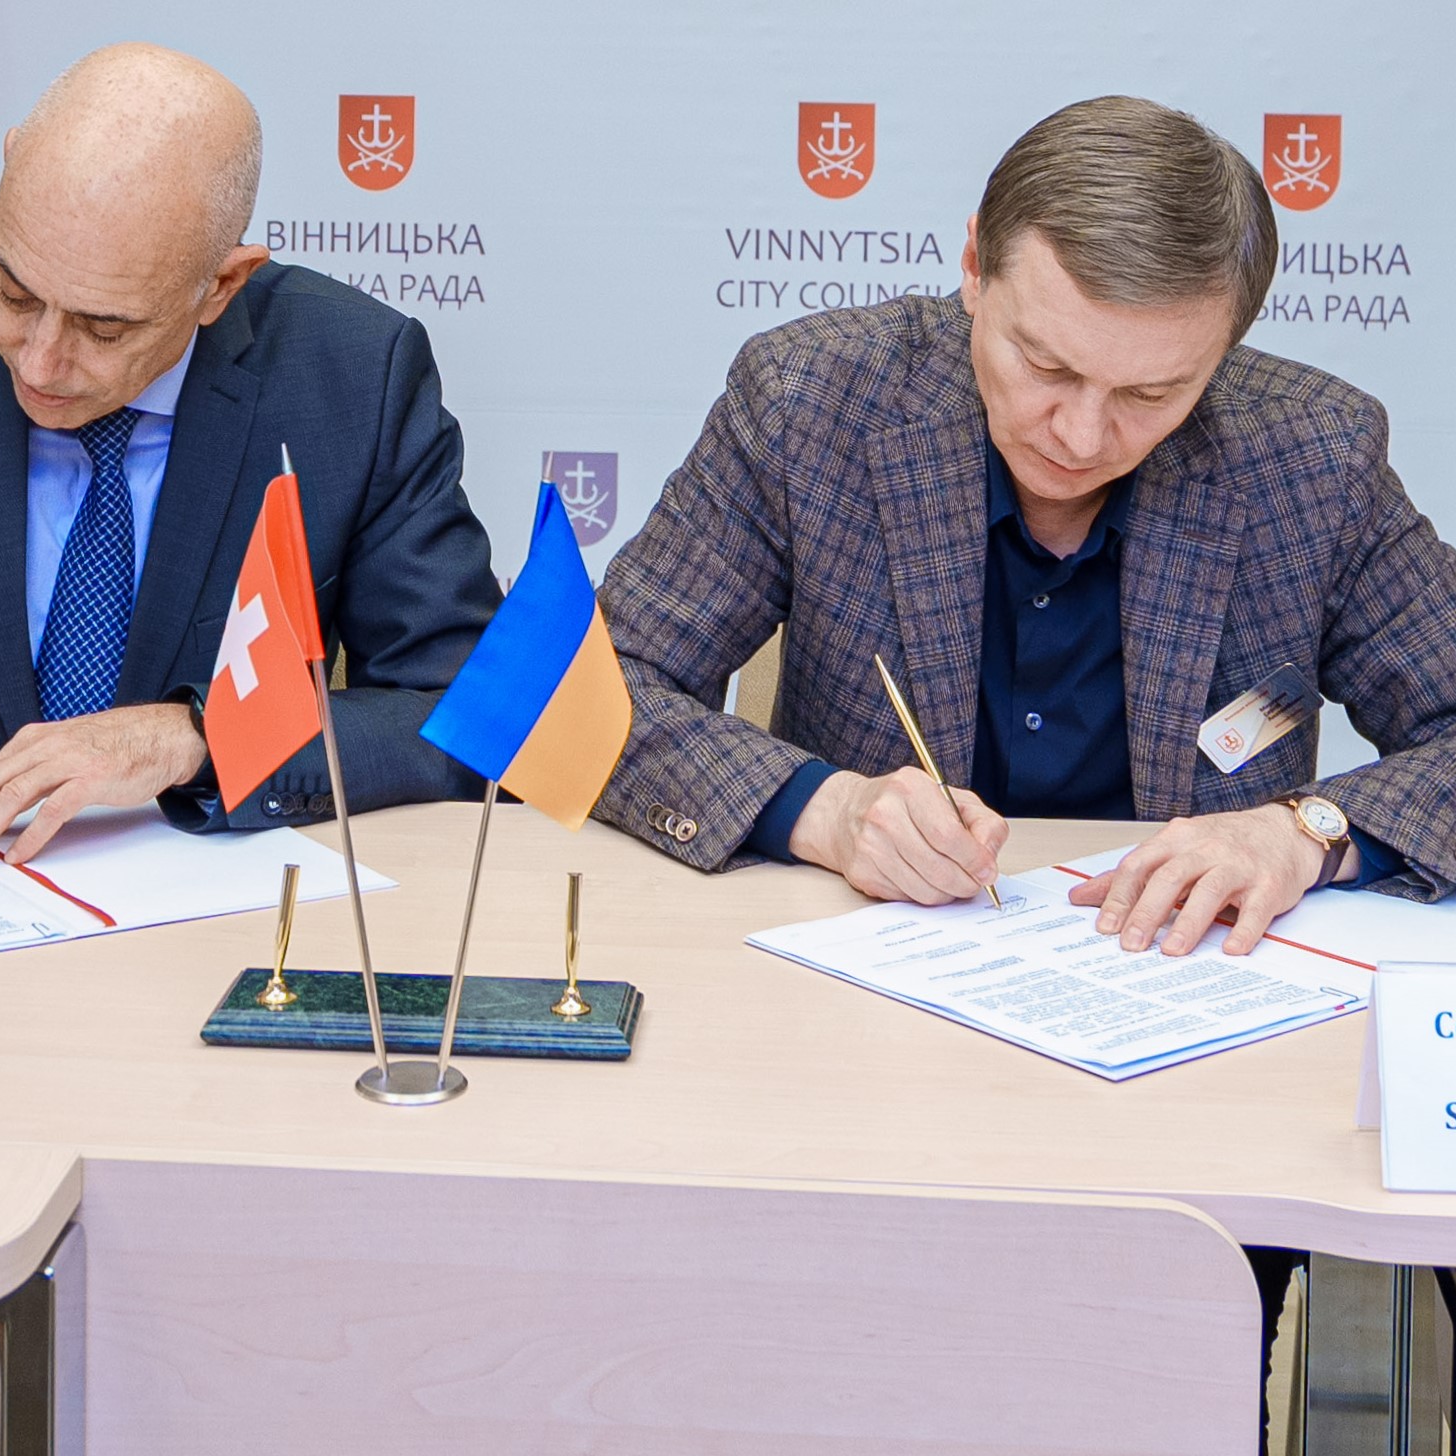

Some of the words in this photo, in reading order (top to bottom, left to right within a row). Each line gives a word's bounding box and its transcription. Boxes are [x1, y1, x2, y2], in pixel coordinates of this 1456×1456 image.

[266, 220, 486, 263] ВІННИЦЬКА
[725, 227, 944, 265] VINNYTSIA
[1282, 242, 1412, 284] ИЦЬКА
[399, 273, 486, 311] РАДА
[716, 279, 789, 309] CITY
[1324, 294, 1411, 331] РАДА
